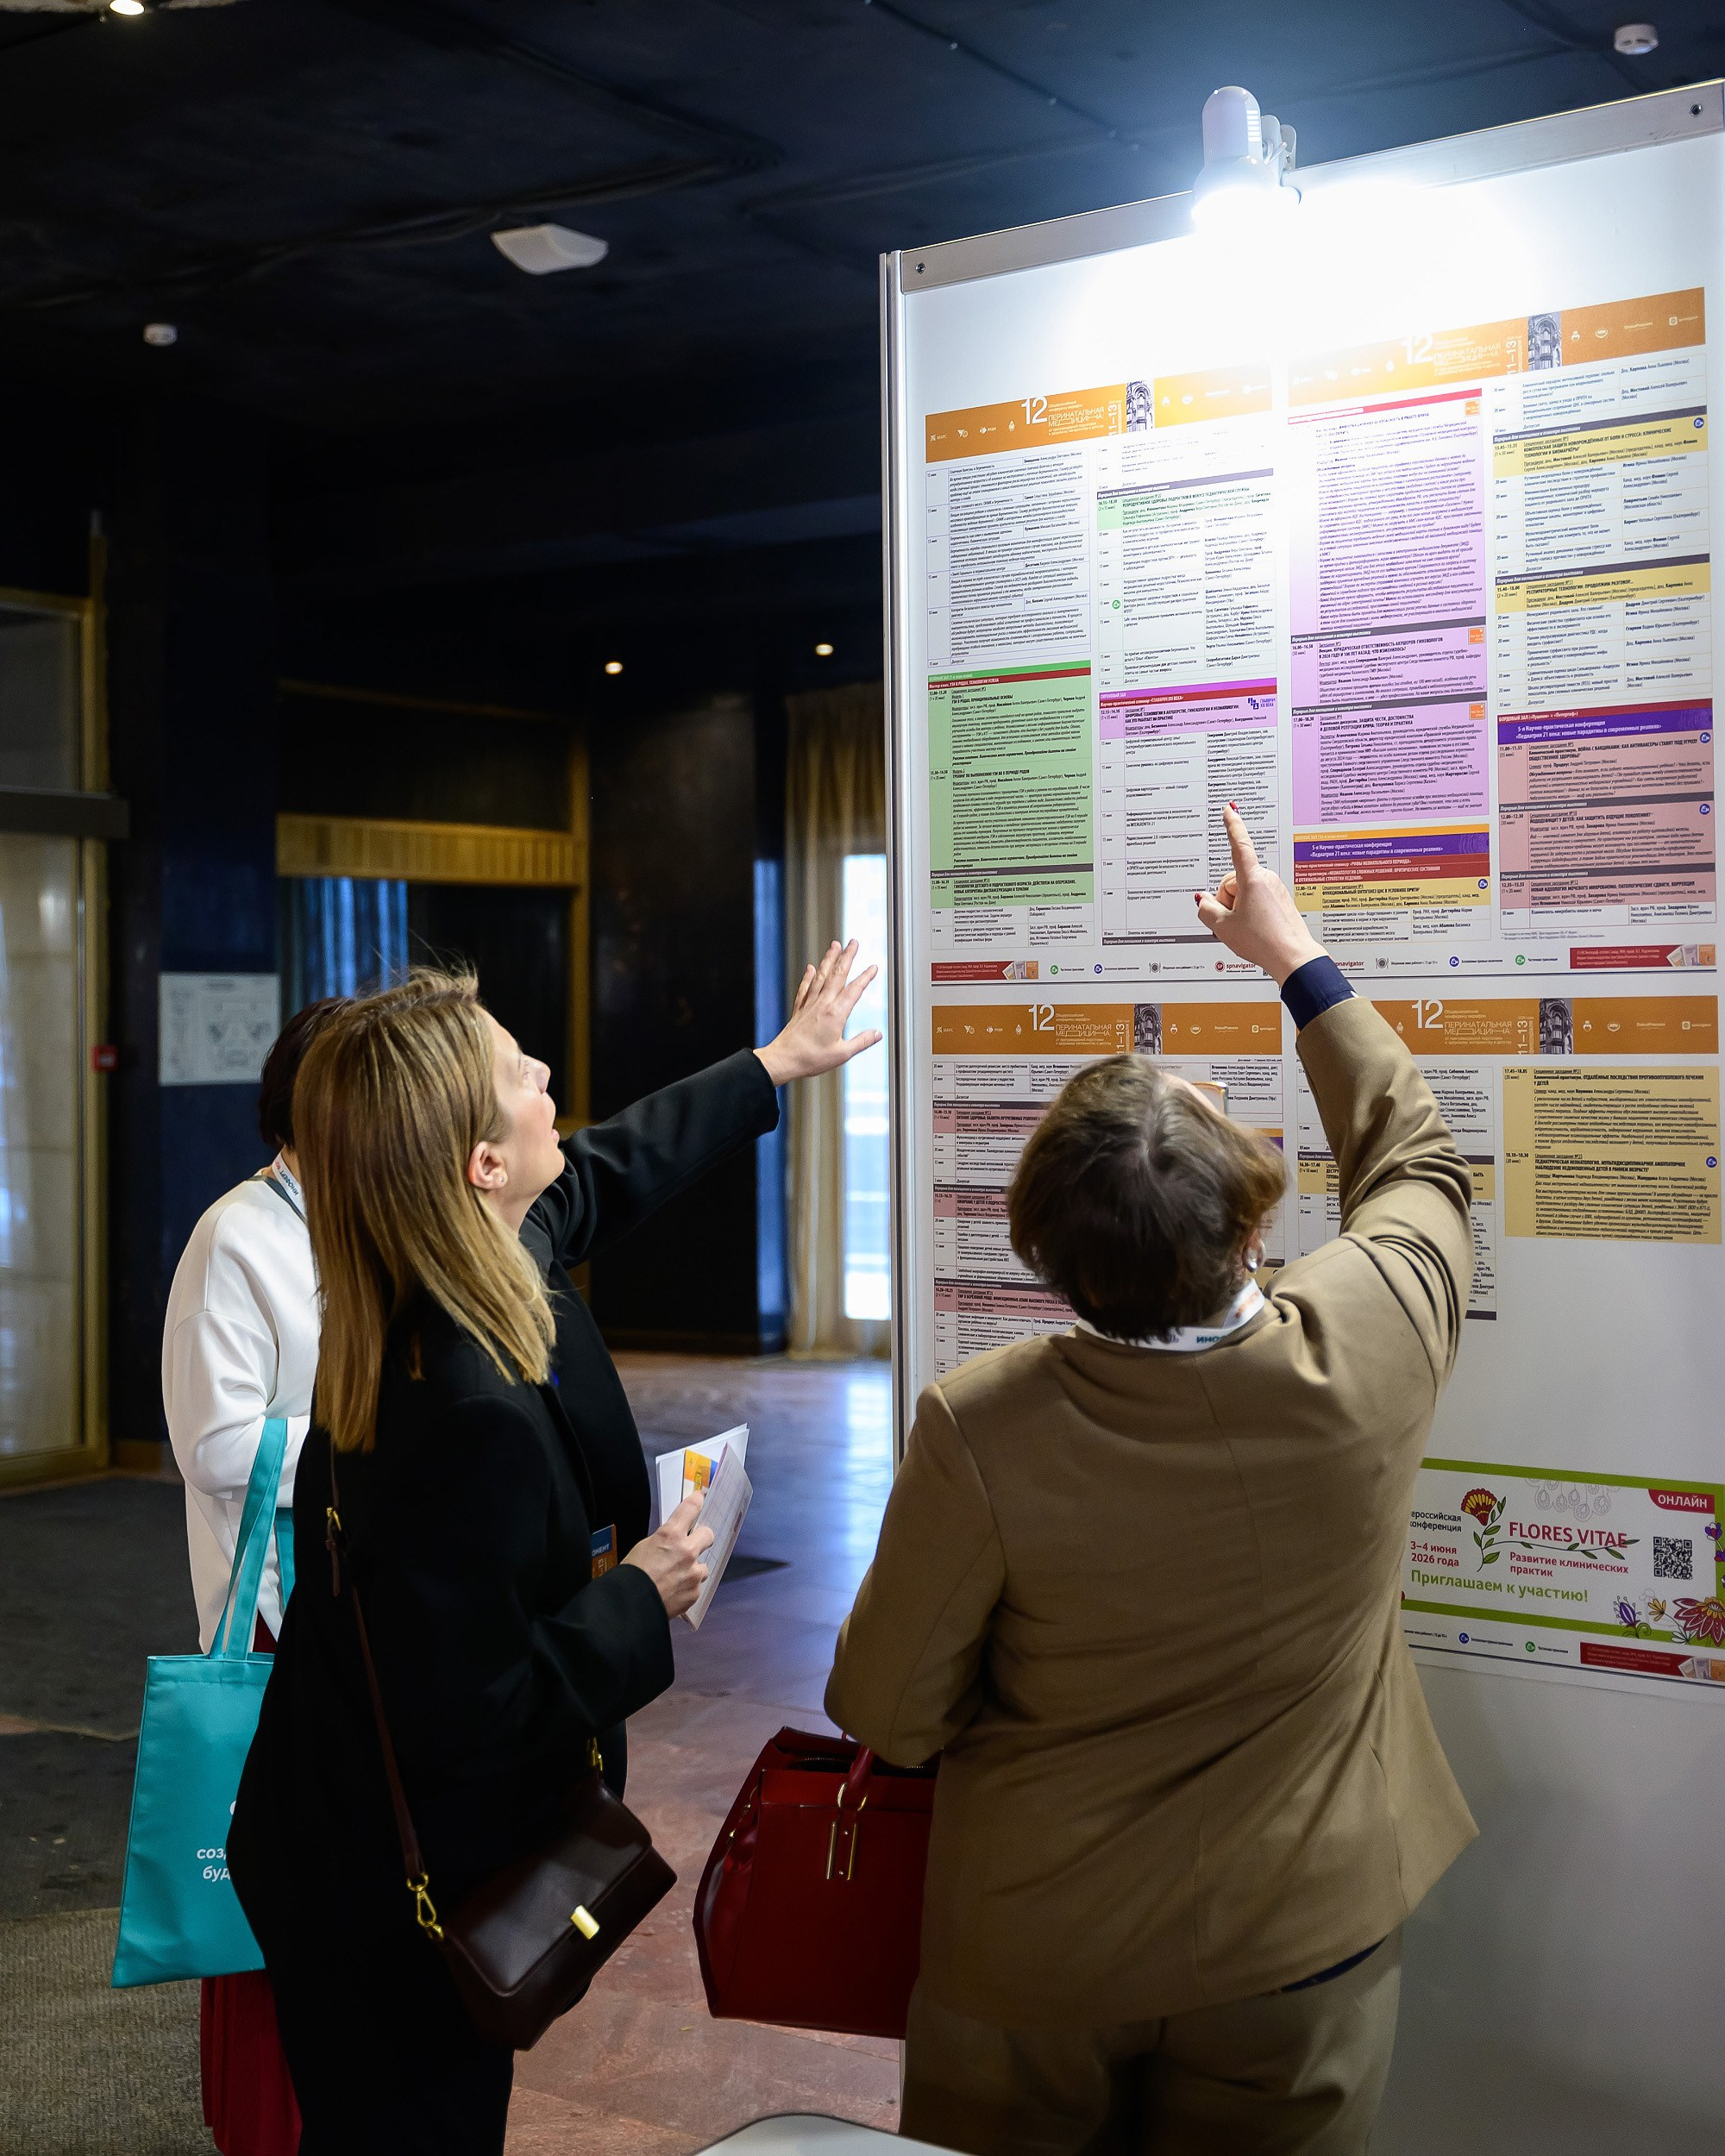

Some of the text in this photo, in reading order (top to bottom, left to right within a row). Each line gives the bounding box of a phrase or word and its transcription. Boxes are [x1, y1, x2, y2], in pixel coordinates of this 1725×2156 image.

[1402, 334, 1433, 365] 12
[1021, 397, 1048, 425] 12
[1048, 407, 1104, 421] ПЕРИНАТАЛЬНАЯ
[1028, 1004, 1055, 1031] 12
[1412, 1000, 1443, 1028] 12
[1658, 1495, 1707, 1508] ОНЛАЙН
[1411, 1511, 1461, 1522] ероссийская
[1509, 1522, 1628, 1548] FLORES VITAE
[1410, 1541, 1457, 1554] 3–4 июня
[1411, 1553, 1459, 1567] 2026 года
[1509, 1551, 1628, 1574] Развитие клинических
[1510, 1565, 1553, 1577] практик
[1411, 1570, 1588, 1603] Приглашаем к участию!
[203, 1865, 230, 1882] буд
